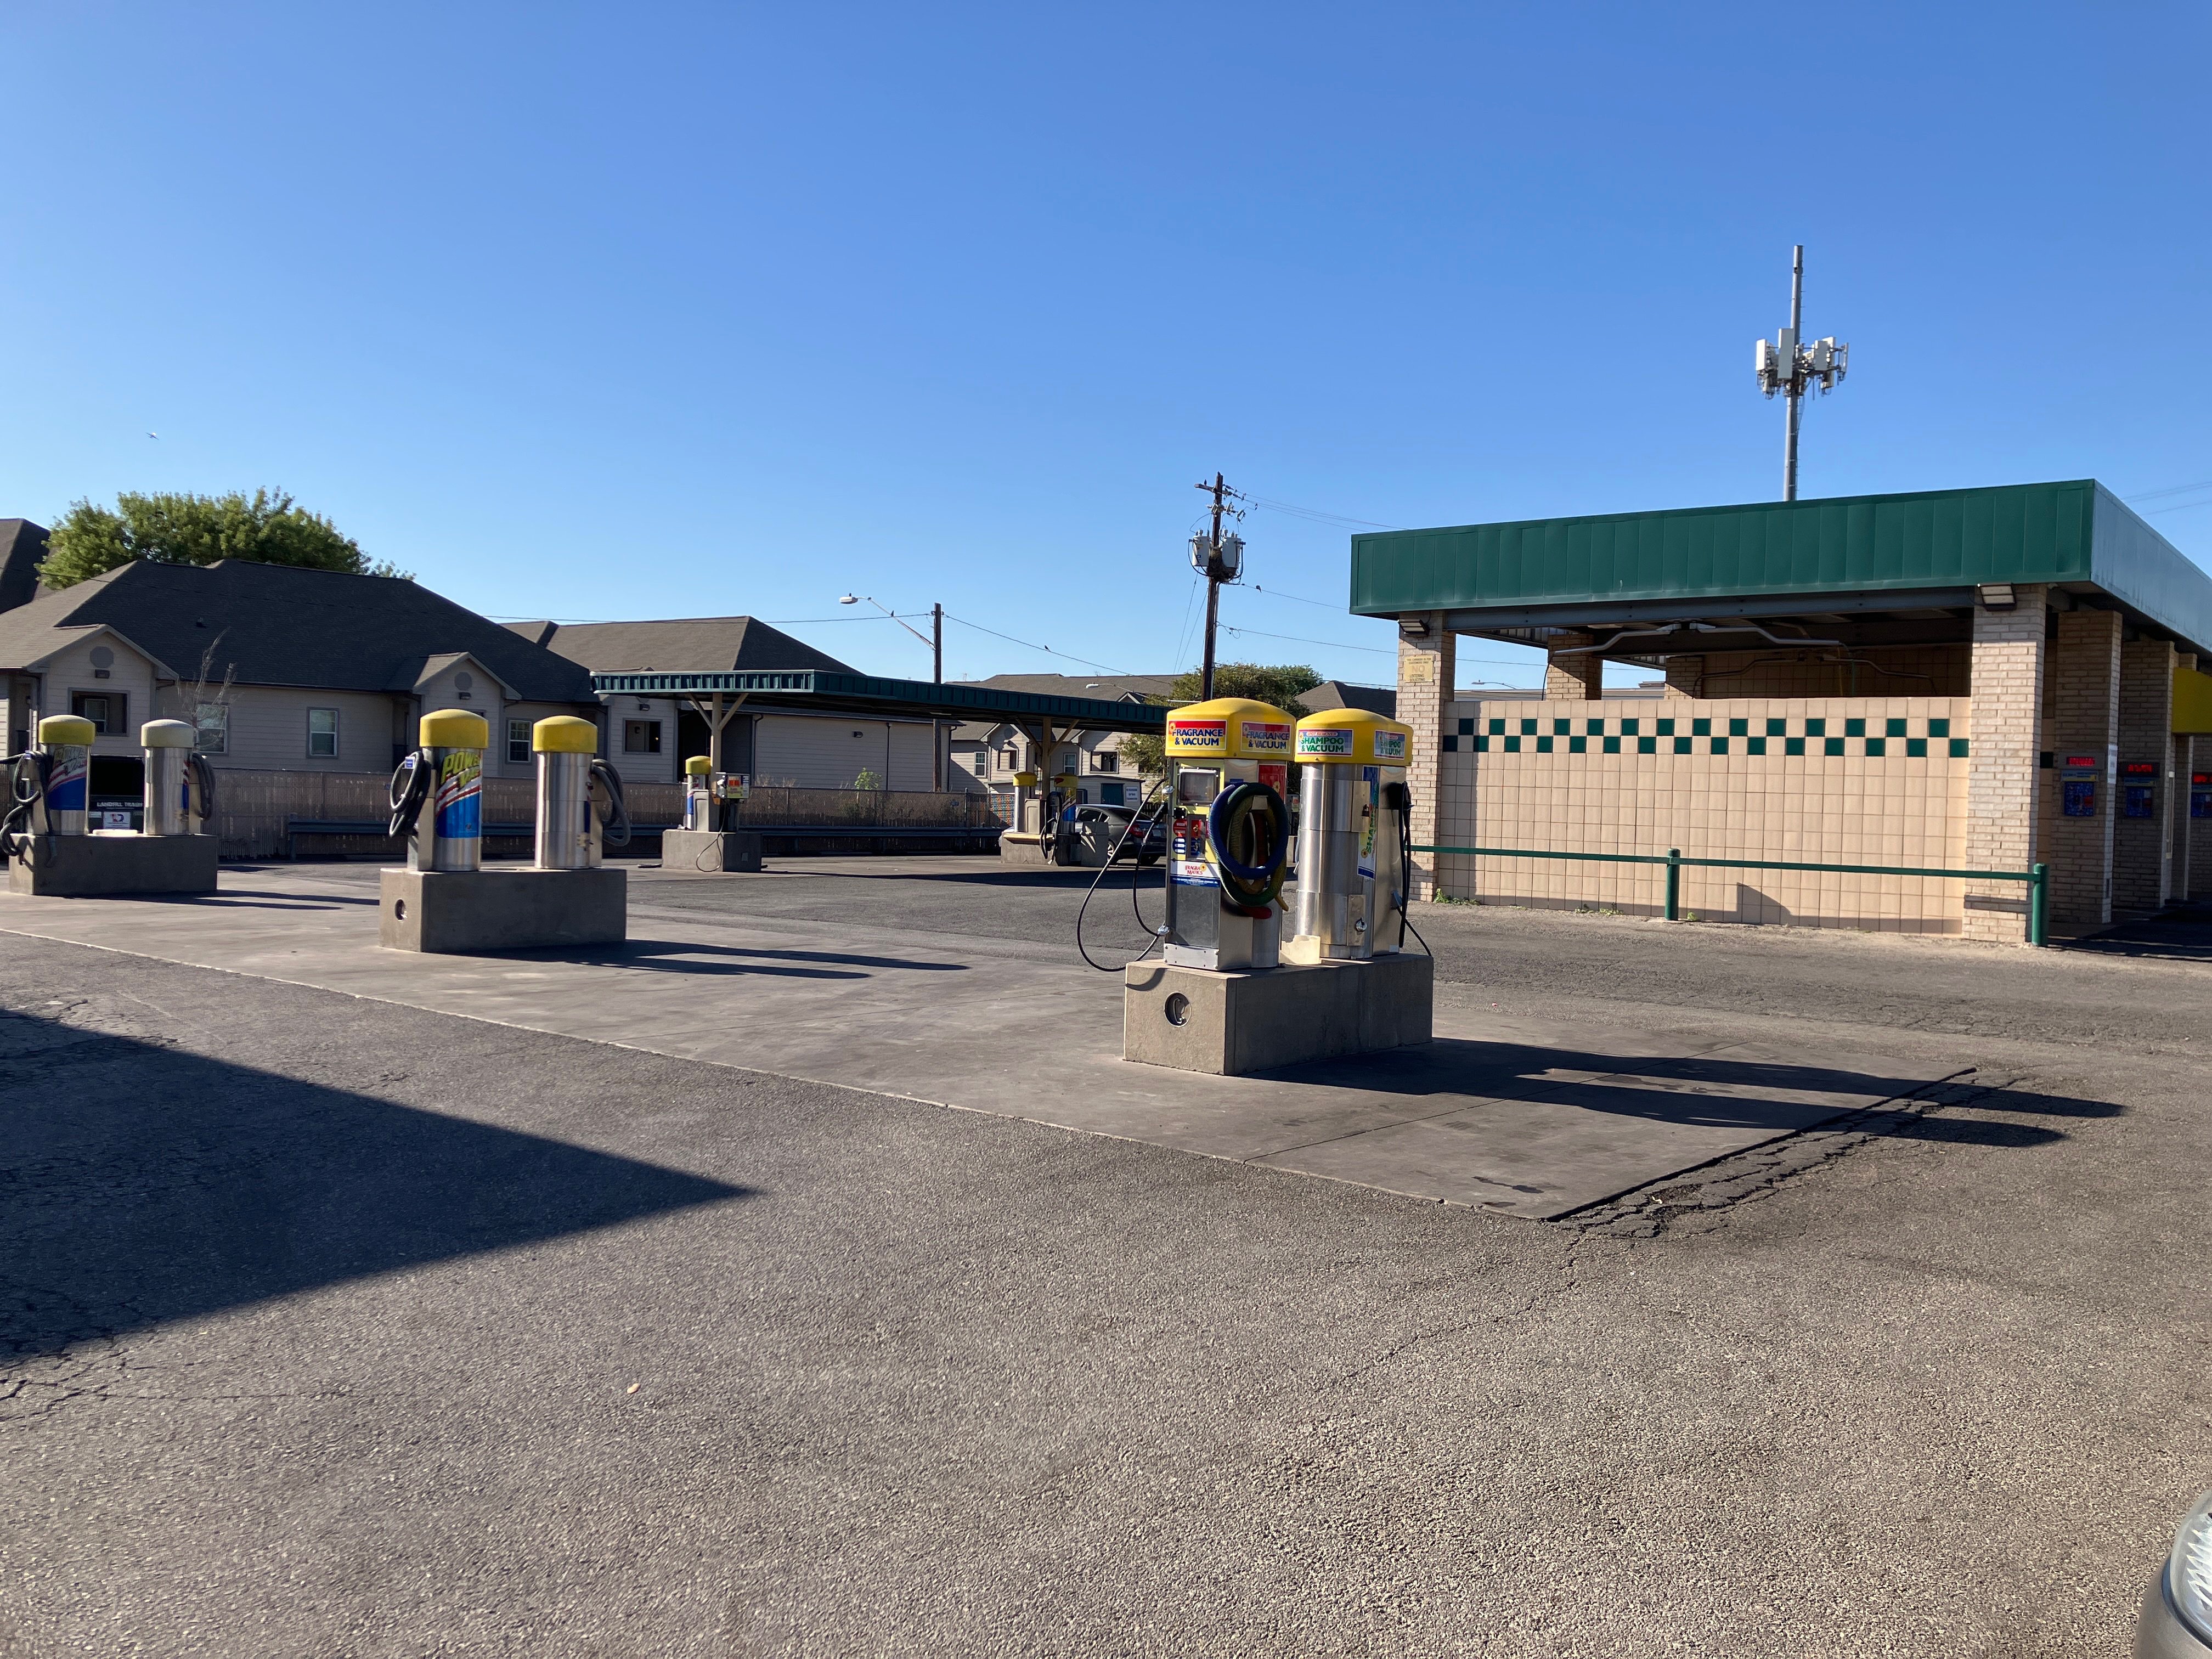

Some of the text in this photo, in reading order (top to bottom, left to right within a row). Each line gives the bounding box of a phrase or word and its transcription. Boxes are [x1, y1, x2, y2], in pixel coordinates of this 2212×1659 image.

[1172, 729, 1223, 737] FRAGRANCE
[1246, 730, 1290, 740] FRAGRANCE
[1182, 737, 1219, 746] VACUUM
[1248, 739, 1286, 749] & VACUUM
[1380, 740, 1401, 748] SAMPOO
[441, 751, 480, 785] POWE
